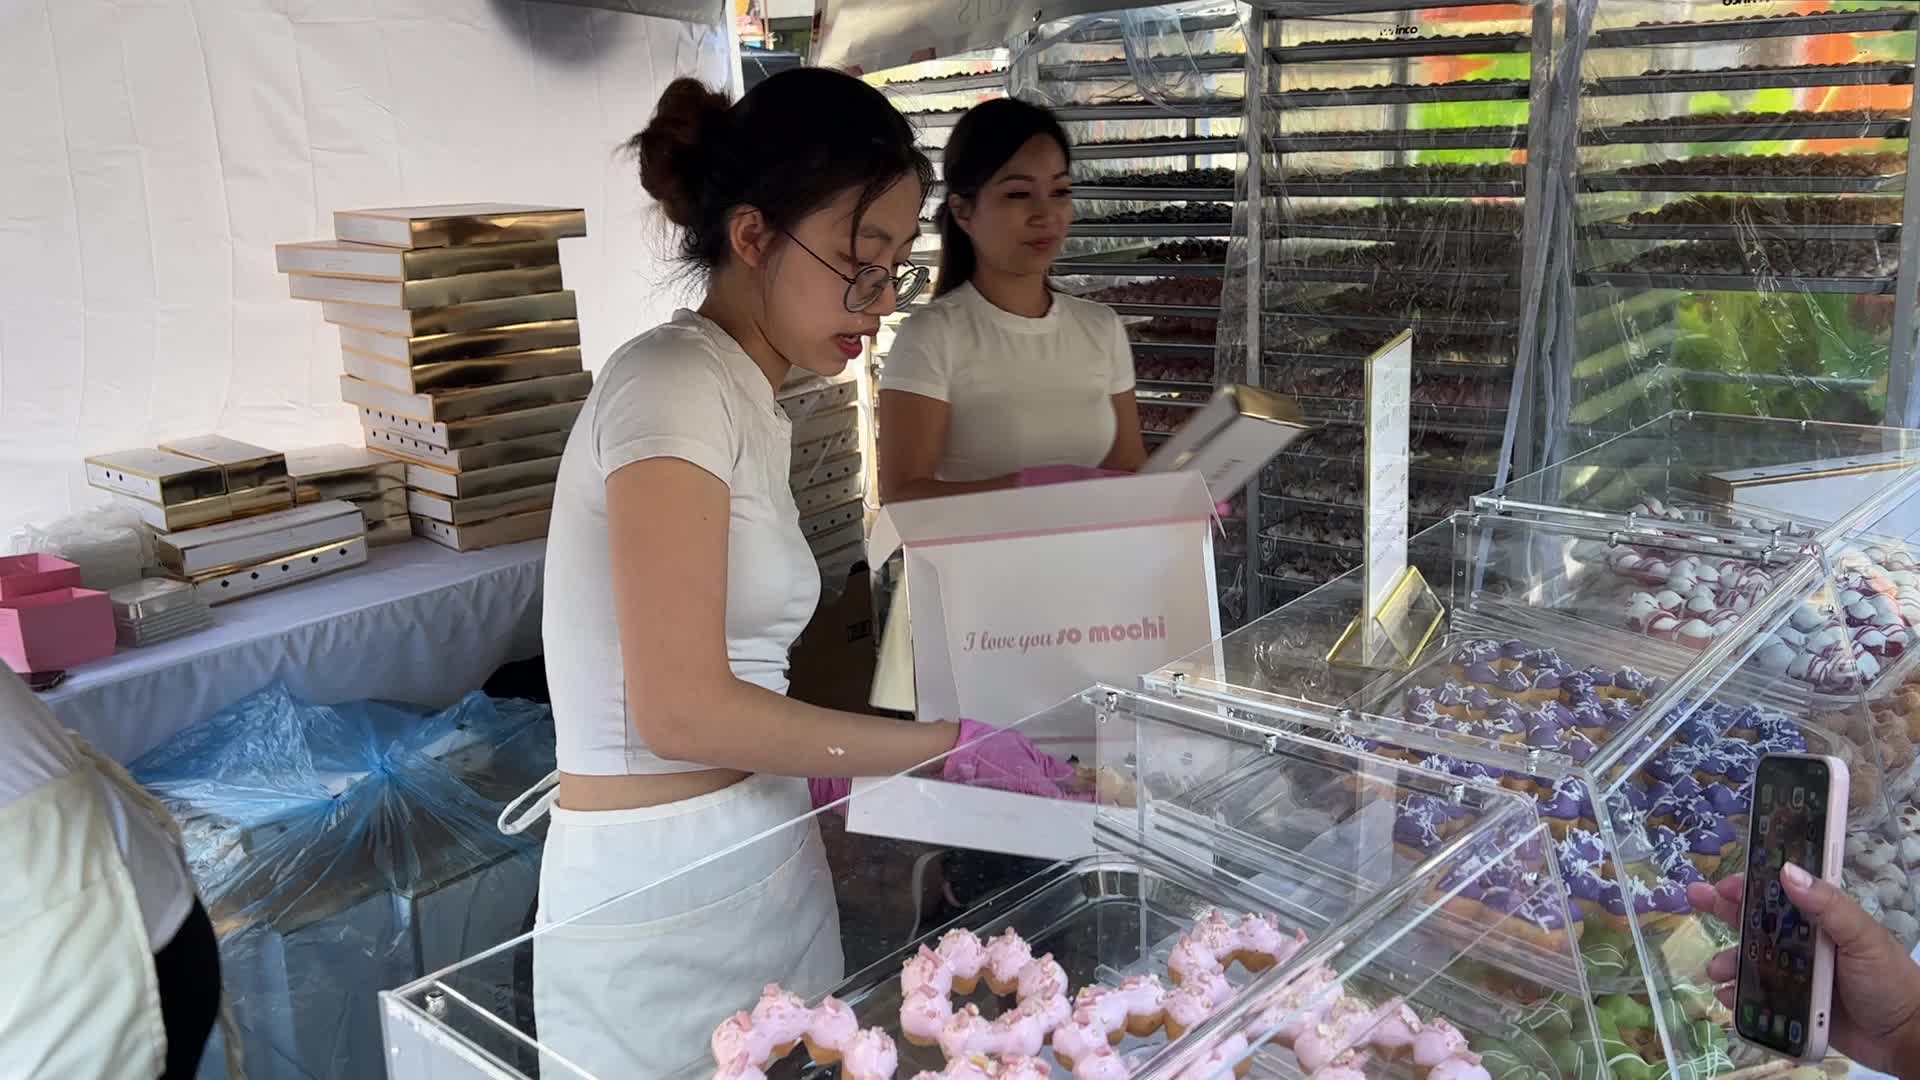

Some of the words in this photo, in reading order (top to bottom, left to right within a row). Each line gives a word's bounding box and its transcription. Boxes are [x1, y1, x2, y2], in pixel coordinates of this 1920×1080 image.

[963, 631, 976, 651] I
[981, 630, 1016, 650] love
[1019, 633, 1051, 653] you
[1056, 627, 1082, 645] so
[1088, 615, 1165, 644] mochi
